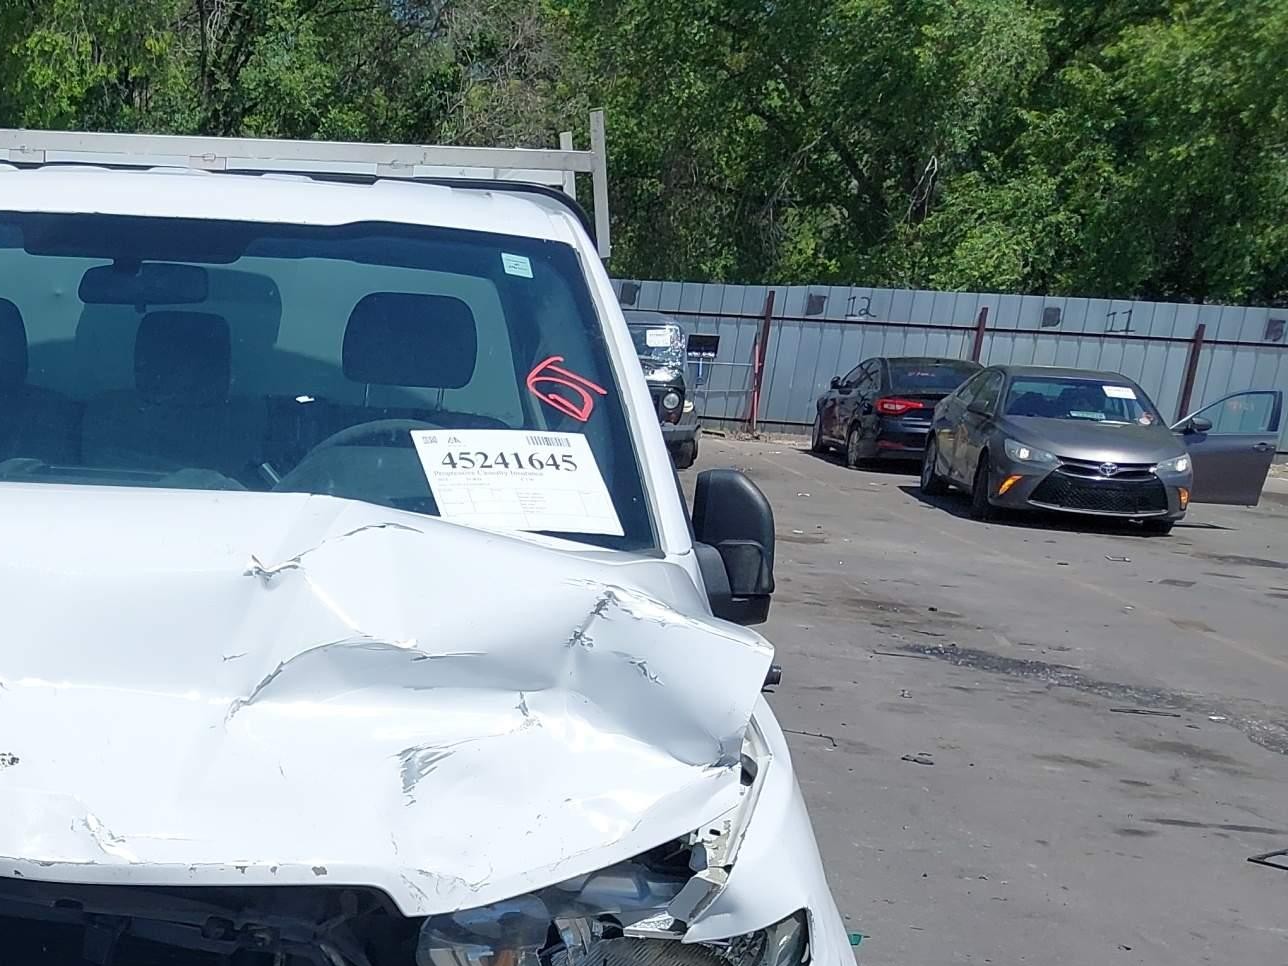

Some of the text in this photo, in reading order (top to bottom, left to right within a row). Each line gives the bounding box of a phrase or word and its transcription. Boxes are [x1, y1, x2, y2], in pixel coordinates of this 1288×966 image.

[844, 295, 877, 319] 12
[1105, 308, 1136, 333] 11
[441, 451, 579, 472] 45241645
